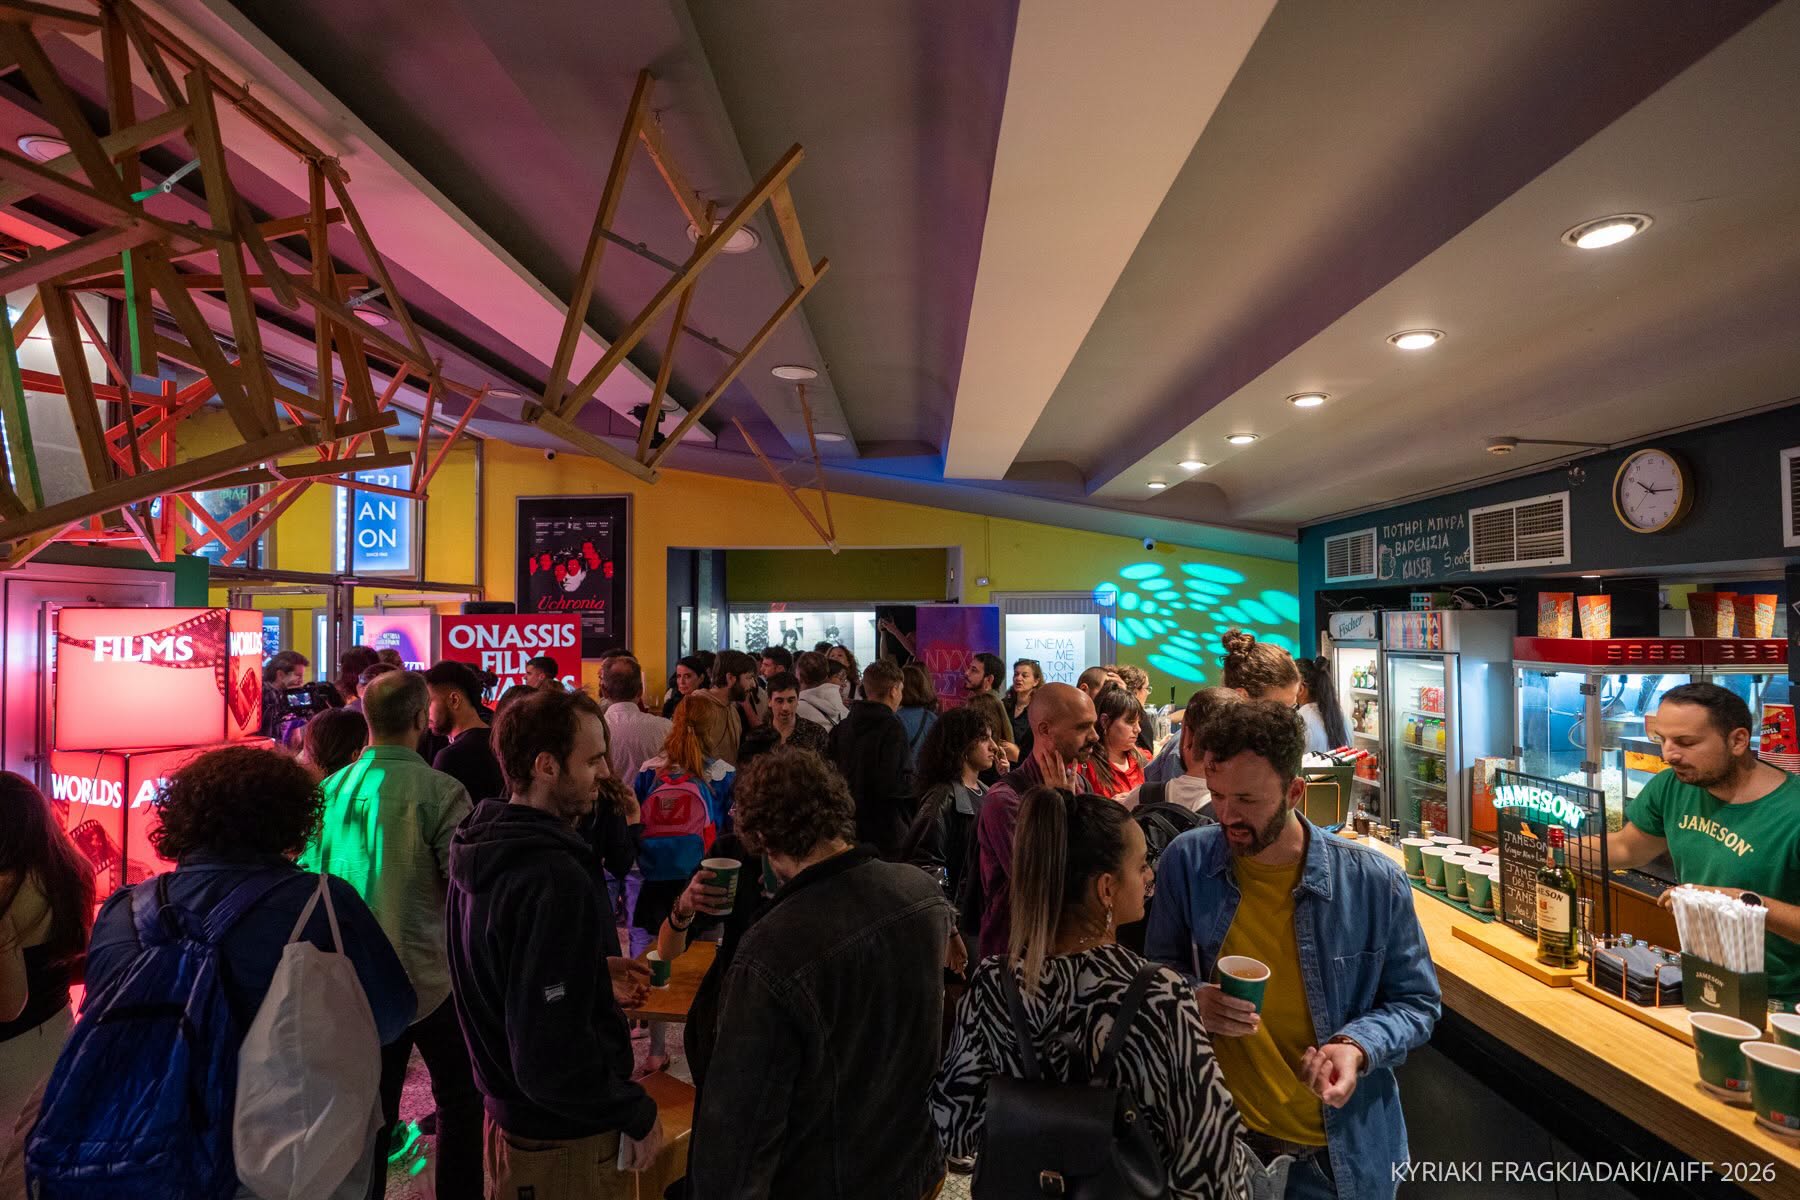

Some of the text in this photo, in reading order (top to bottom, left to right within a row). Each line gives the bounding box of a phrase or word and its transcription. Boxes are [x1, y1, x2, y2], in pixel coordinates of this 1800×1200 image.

[358, 501, 397, 521] AN
[358, 528, 397, 548] ON
[1383, 514, 1465, 539] ΠΟΤΗΡΙ ΜΠΥΡΑ
[537, 594, 605, 610] Uchronia
[448, 623, 576, 649] ONASSIS
[1338, 614, 1364, 638] Fischer
[93, 635, 193, 663] FILMS
[229, 632, 263, 657] WORLDS
[1025, 638, 1074, 650] ΣΙΝΕΜΑ
[1055, 650, 1074, 661] ΜΕ
[923, 648, 976, 673] ΝΥΧ
[1046, 660, 1075, 672] ΤΟΝ
[51, 773, 122, 809] WORLDS
[1492, 785, 1585, 829] JAMESON
[1678, 814, 1751, 857] JAMESON
[1505, 862, 1537, 881] JAME
[1695, 971, 1724, 988] JAMESON
